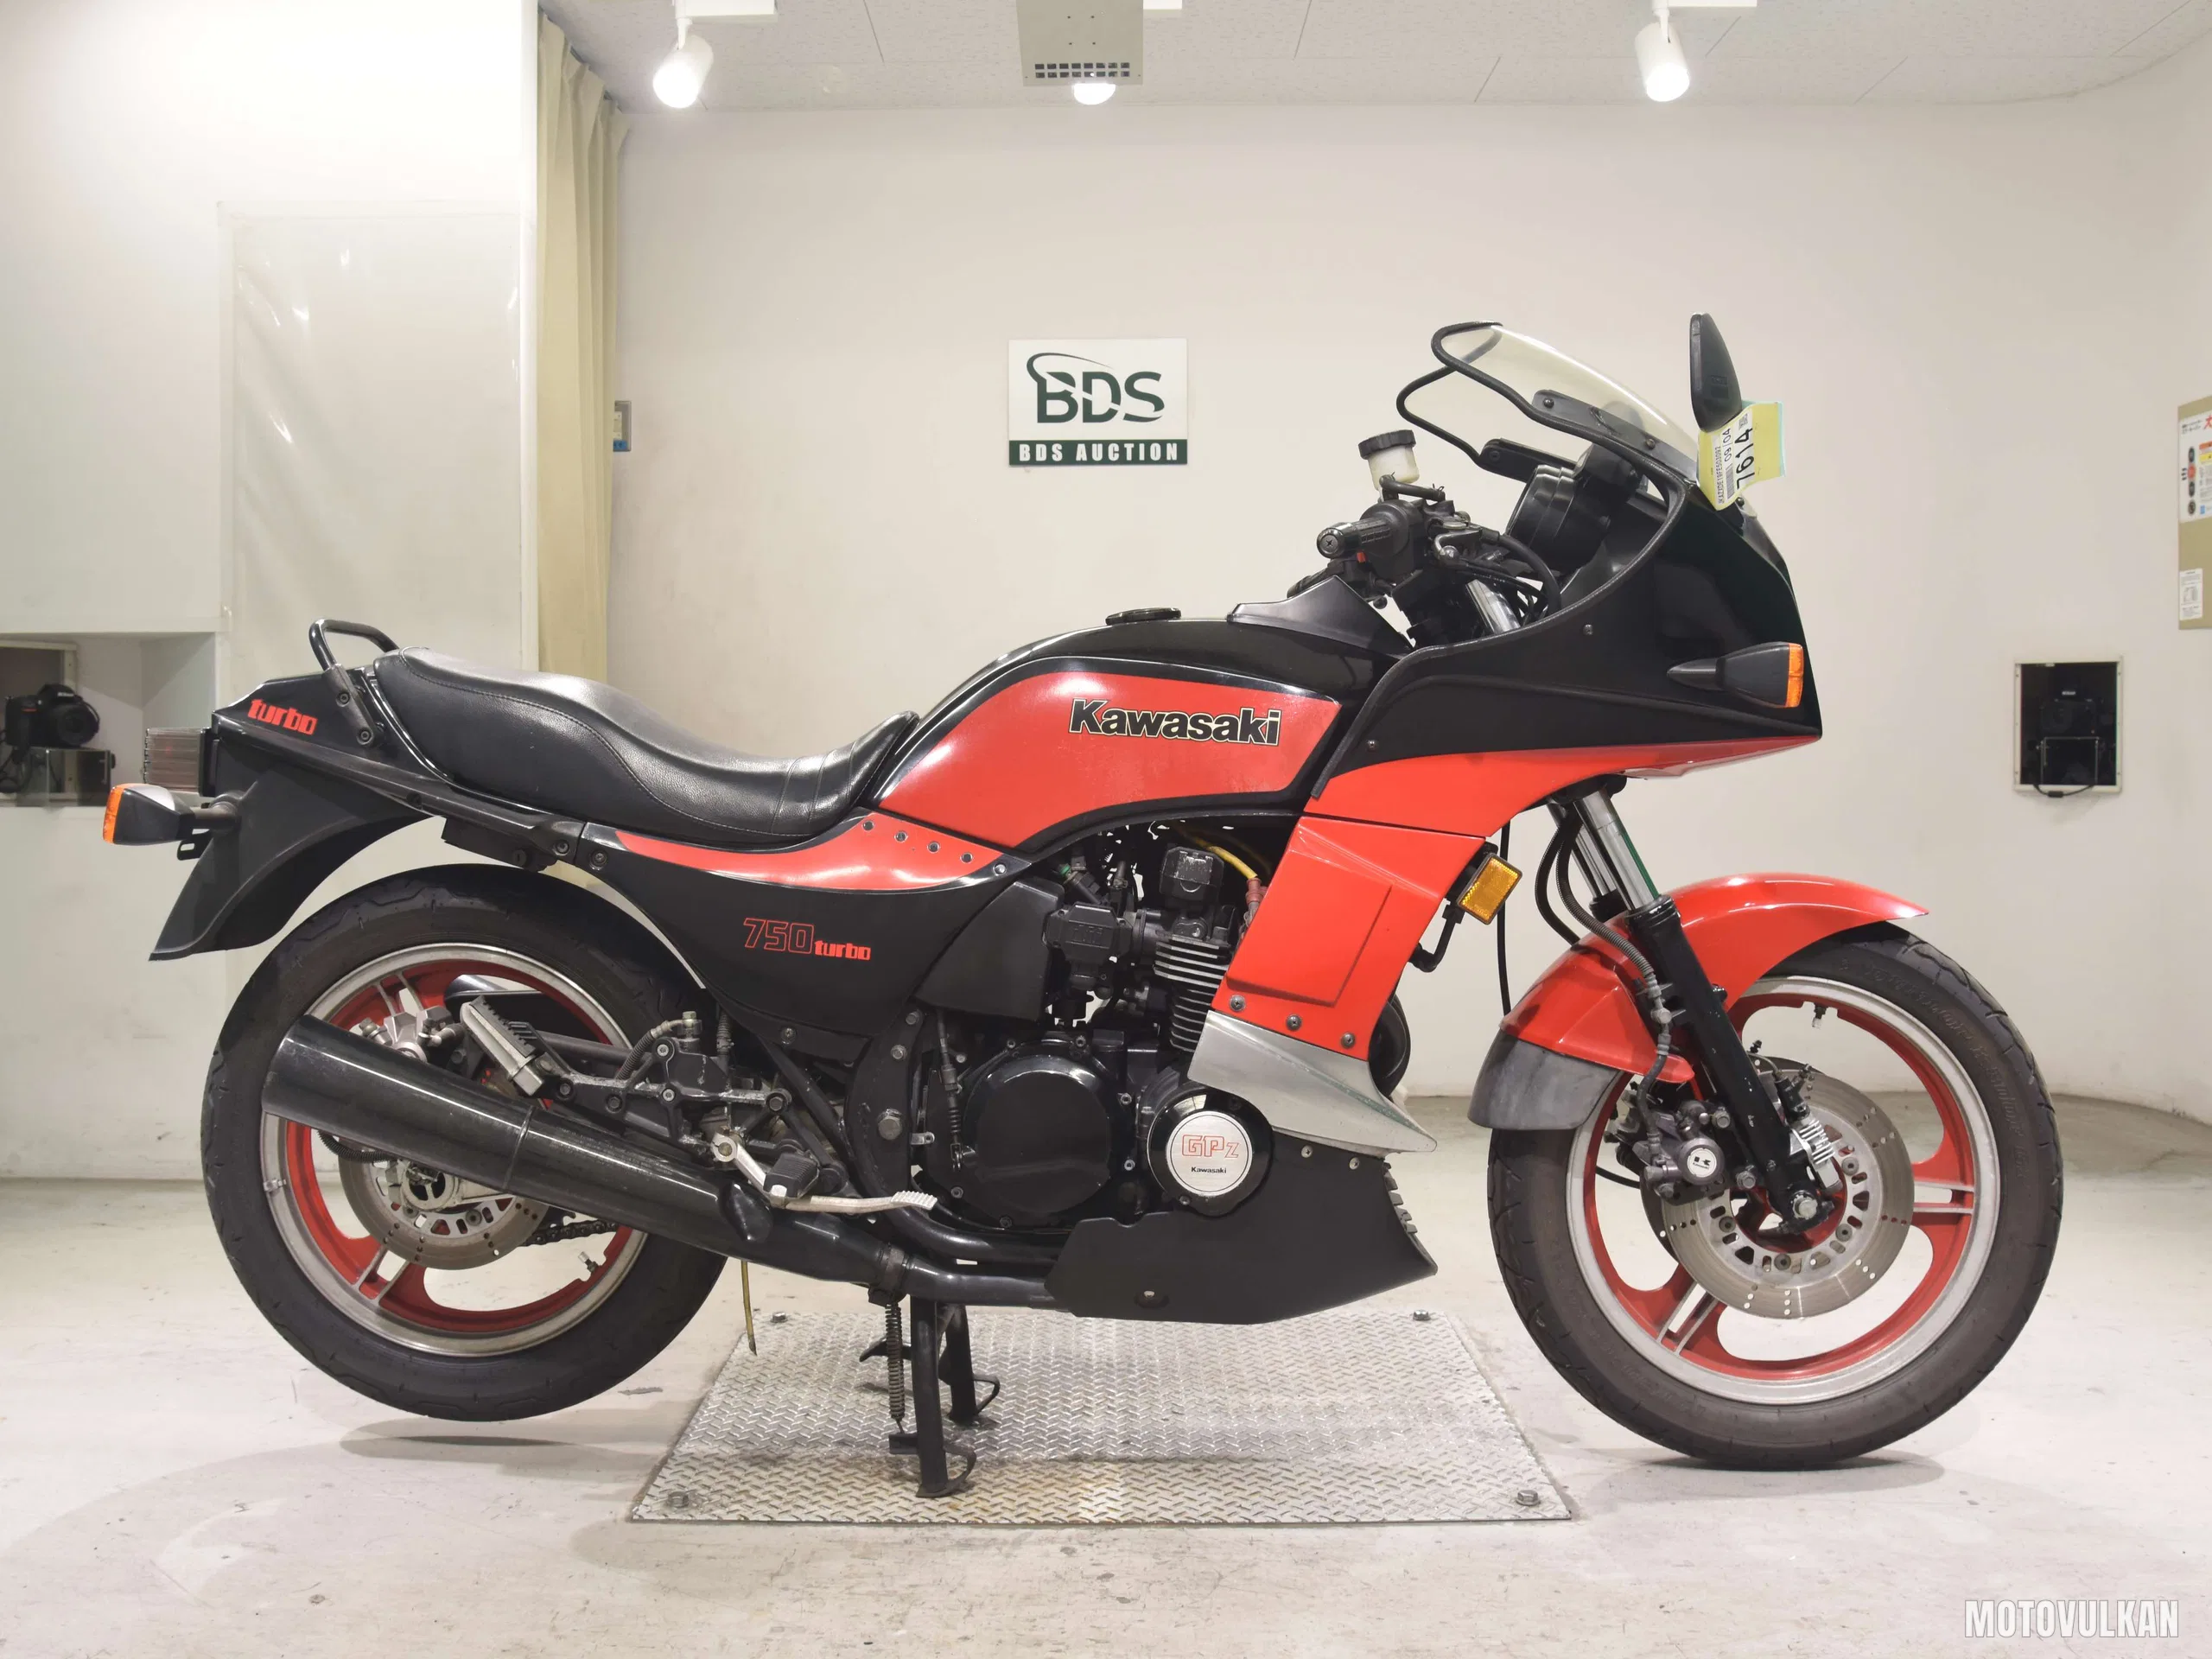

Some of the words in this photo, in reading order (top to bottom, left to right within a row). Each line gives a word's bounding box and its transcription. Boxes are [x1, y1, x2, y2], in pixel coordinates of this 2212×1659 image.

[1027, 353, 1165, 423] BDS
[1019, 443, 1064, 461] BDS
[1076, 442, 1178, 461] AUCTION
[1722, 428, 1733, 462] 09/04
[1734, 428, 1756, 491] 7614
[247, 698, 318, 736] turbo
[1068, 697, 1283, 747] Kawasaki
[743, 917, 815, 955] 750
[814, 939, 872, 961] turbo
